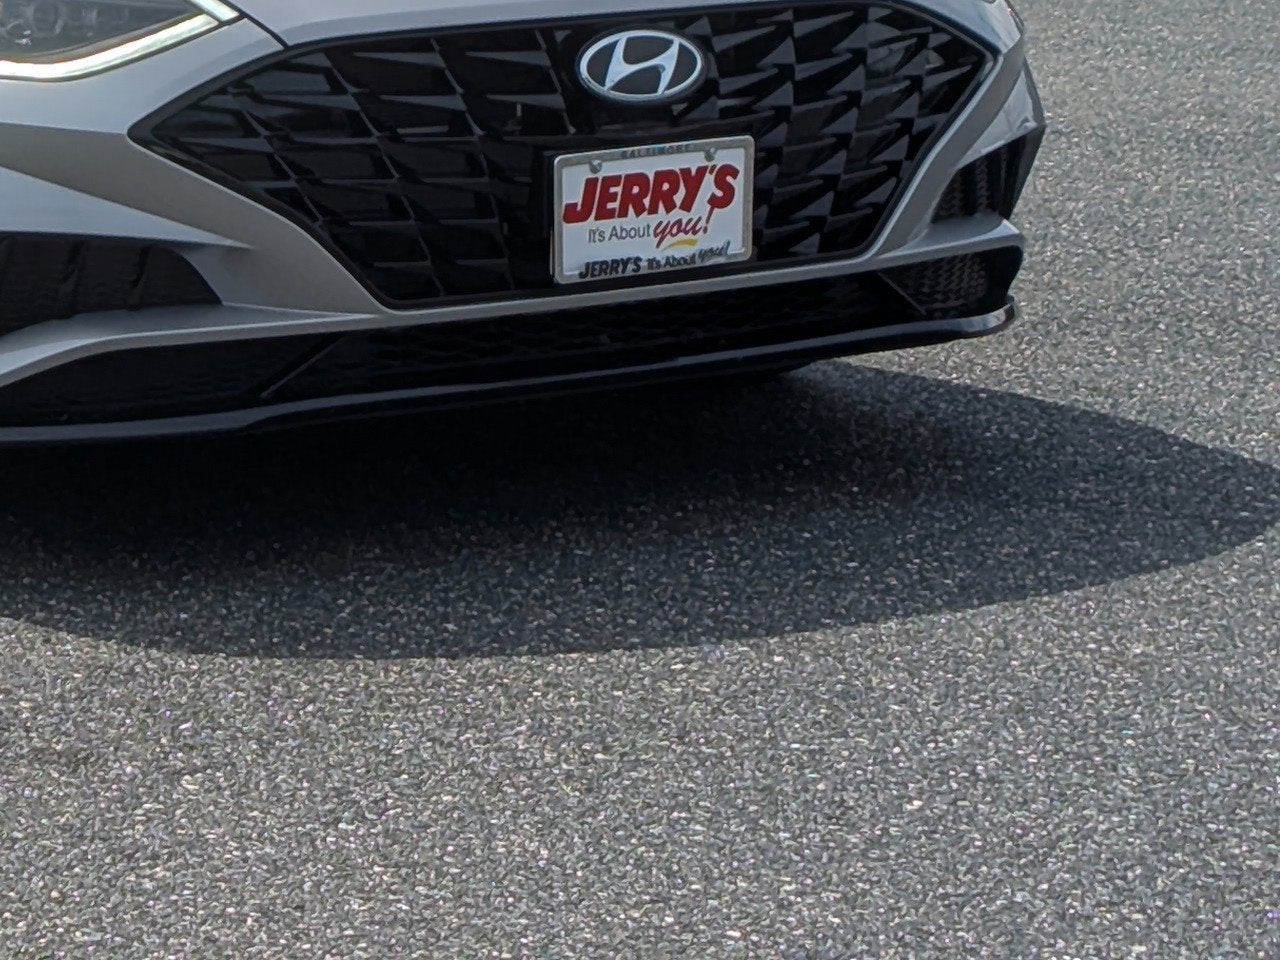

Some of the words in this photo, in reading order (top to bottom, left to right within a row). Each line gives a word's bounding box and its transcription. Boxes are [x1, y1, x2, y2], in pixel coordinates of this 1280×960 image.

[562, 163, 740, 224] JERRY'S
[588, 227, 606, 243] It's
[608, 224, 651, 242] About
[652, 207, 715, 249] you!
[578, 256, 643, 279] JERRY'S
[663, 252, 696, 268] About
